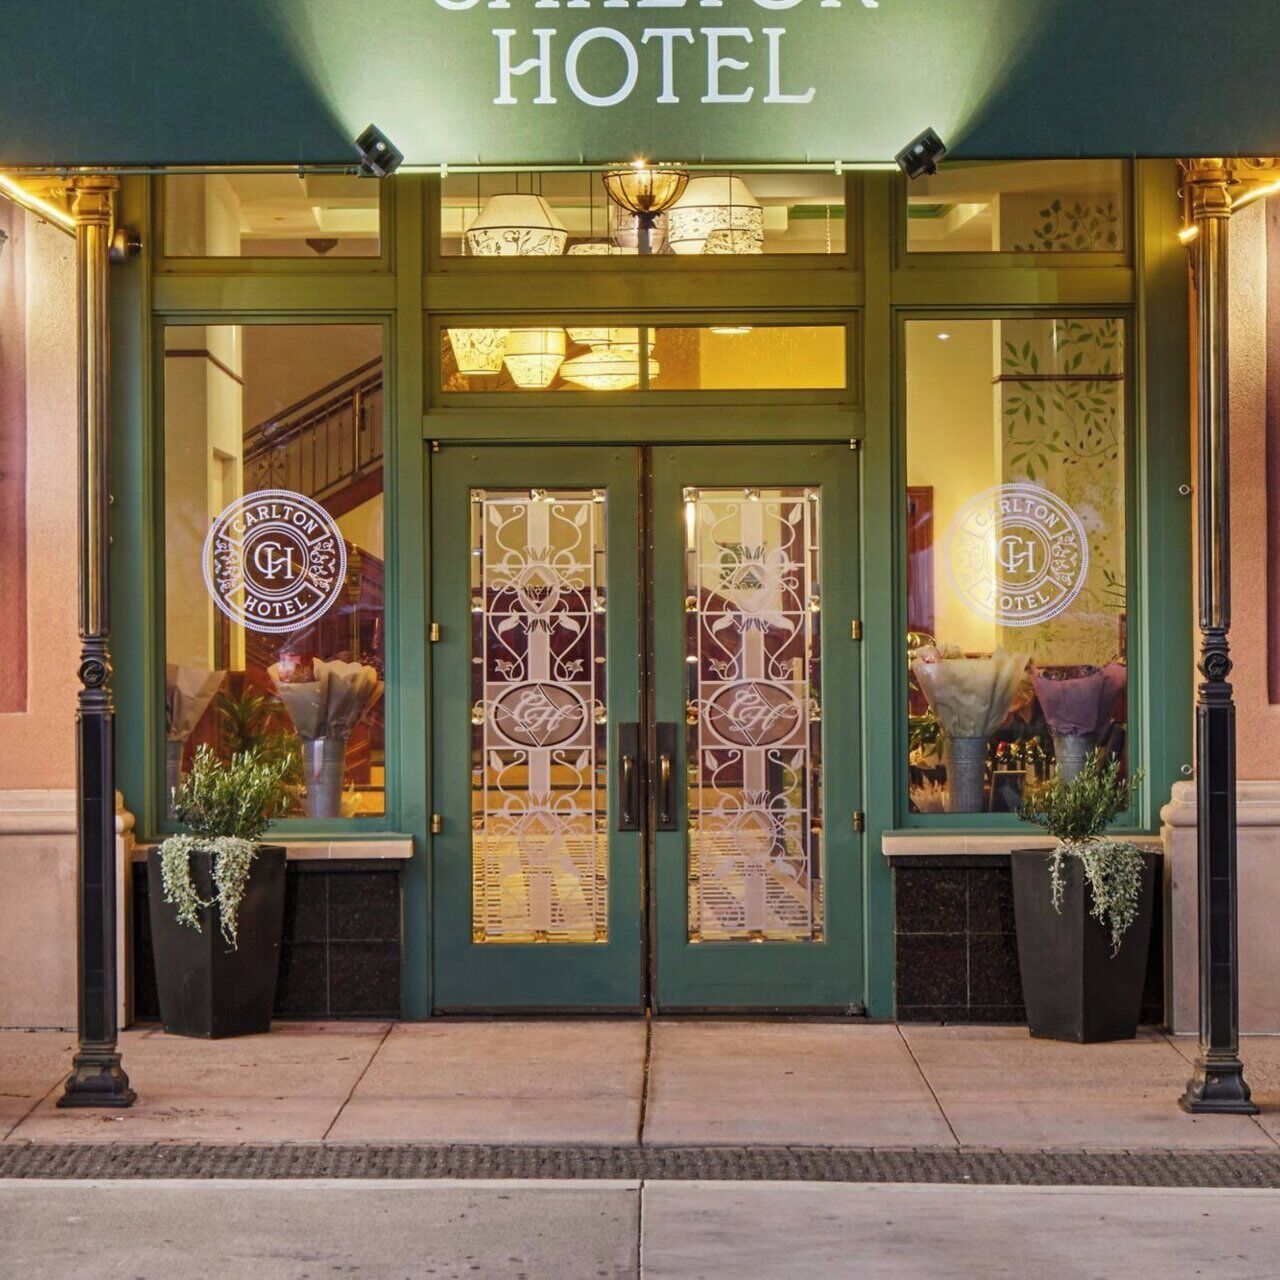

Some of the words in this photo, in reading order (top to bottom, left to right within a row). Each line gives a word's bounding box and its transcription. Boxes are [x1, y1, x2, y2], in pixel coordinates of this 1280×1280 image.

[491, 26, 817, 107] HOTEL
[232, 504, 319, 535] CARLTON
[242, 595, 308, 617] HOTEL
